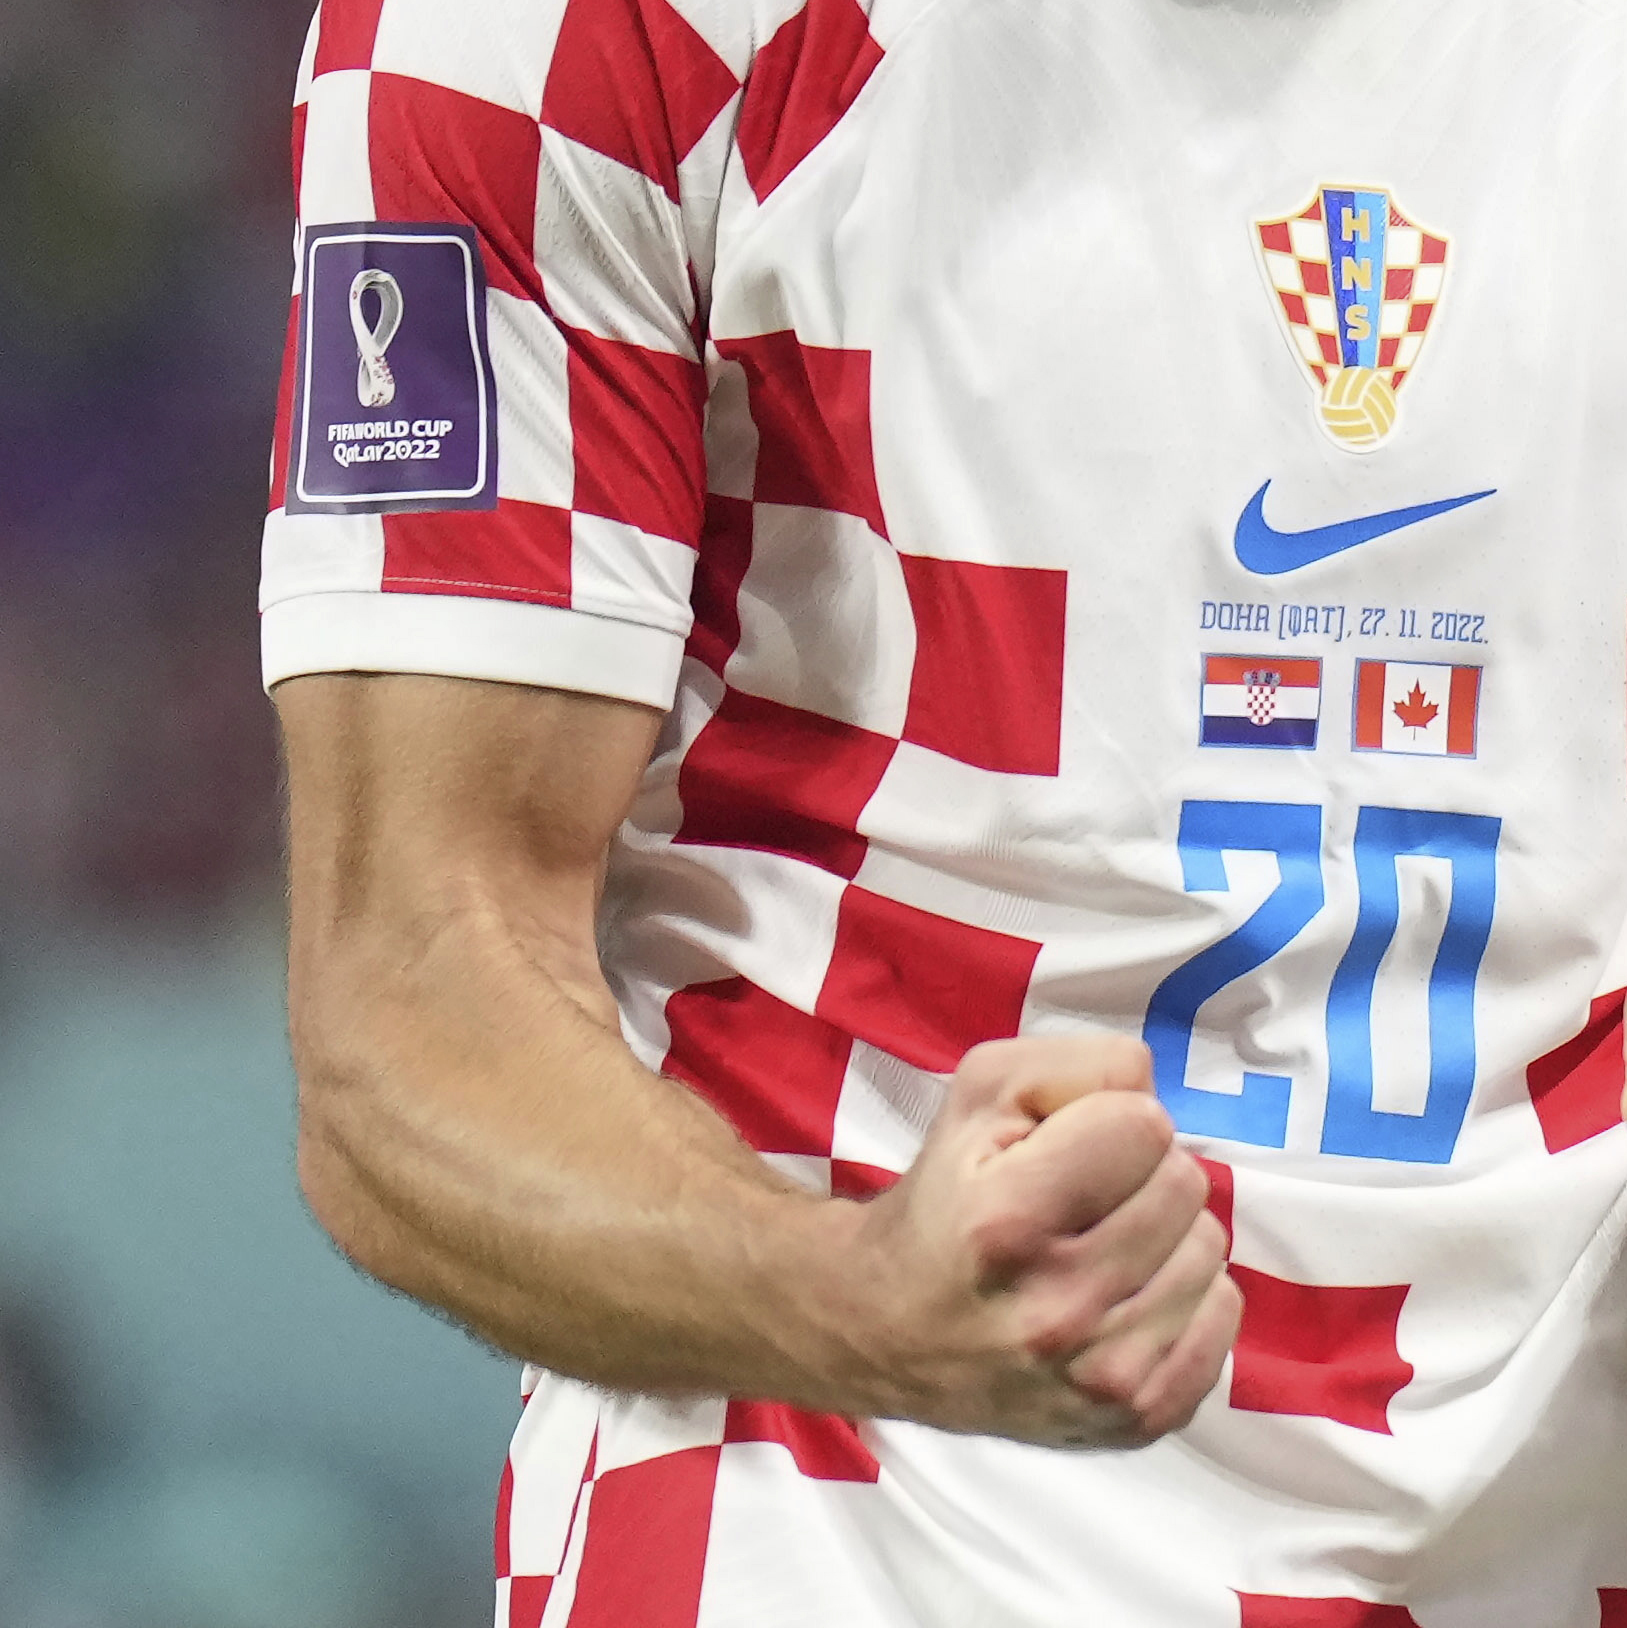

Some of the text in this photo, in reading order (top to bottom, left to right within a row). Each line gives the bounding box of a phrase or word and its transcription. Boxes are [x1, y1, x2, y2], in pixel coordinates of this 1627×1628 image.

[328, 419, 454, 441] FIFA WORLD CUP
[333, 439, 441, 468] Qatar 2022
[1200, 601, 1270, 632] DOHA
[1142, 799, 1502, 1165] 20
